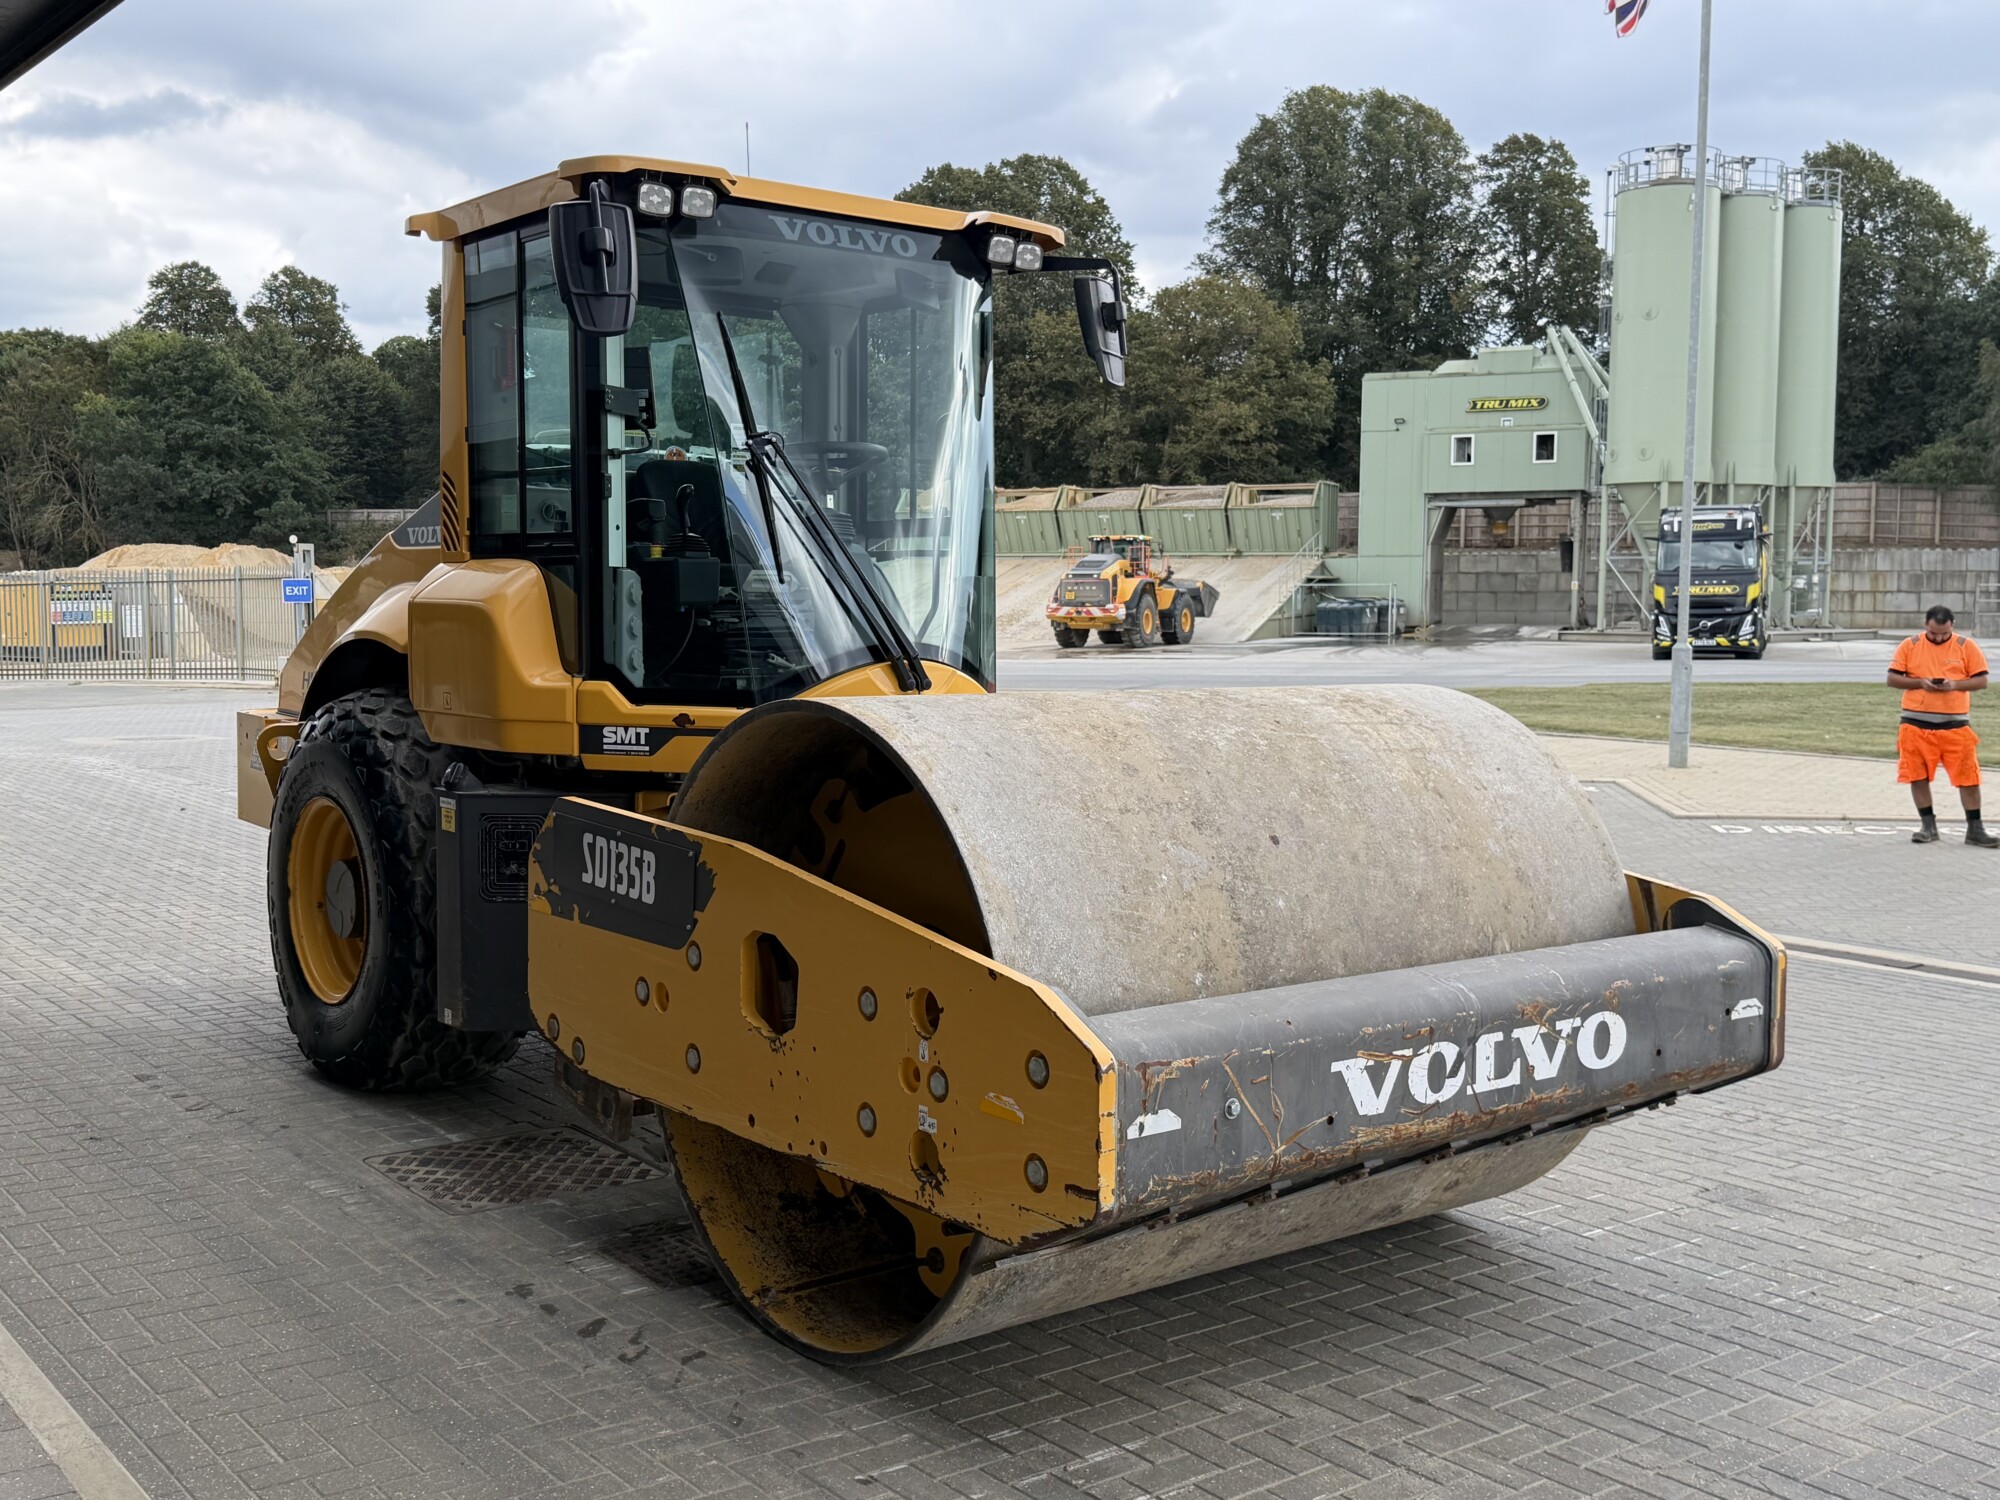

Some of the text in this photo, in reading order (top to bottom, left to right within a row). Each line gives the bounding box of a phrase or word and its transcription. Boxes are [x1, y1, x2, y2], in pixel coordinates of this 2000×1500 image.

[768, 215, 917, 258] VOLVO
[1475, 398, 1541, 409] TRU MIX
[407, 525, 441, 544] VOLV
[285, 586, 309, 596] EXIT
[602, 726, 650, 745] SMT
[582, 832, 656, 905] SD135B
[1330, 1010, 1627, 1117] VOLVO
